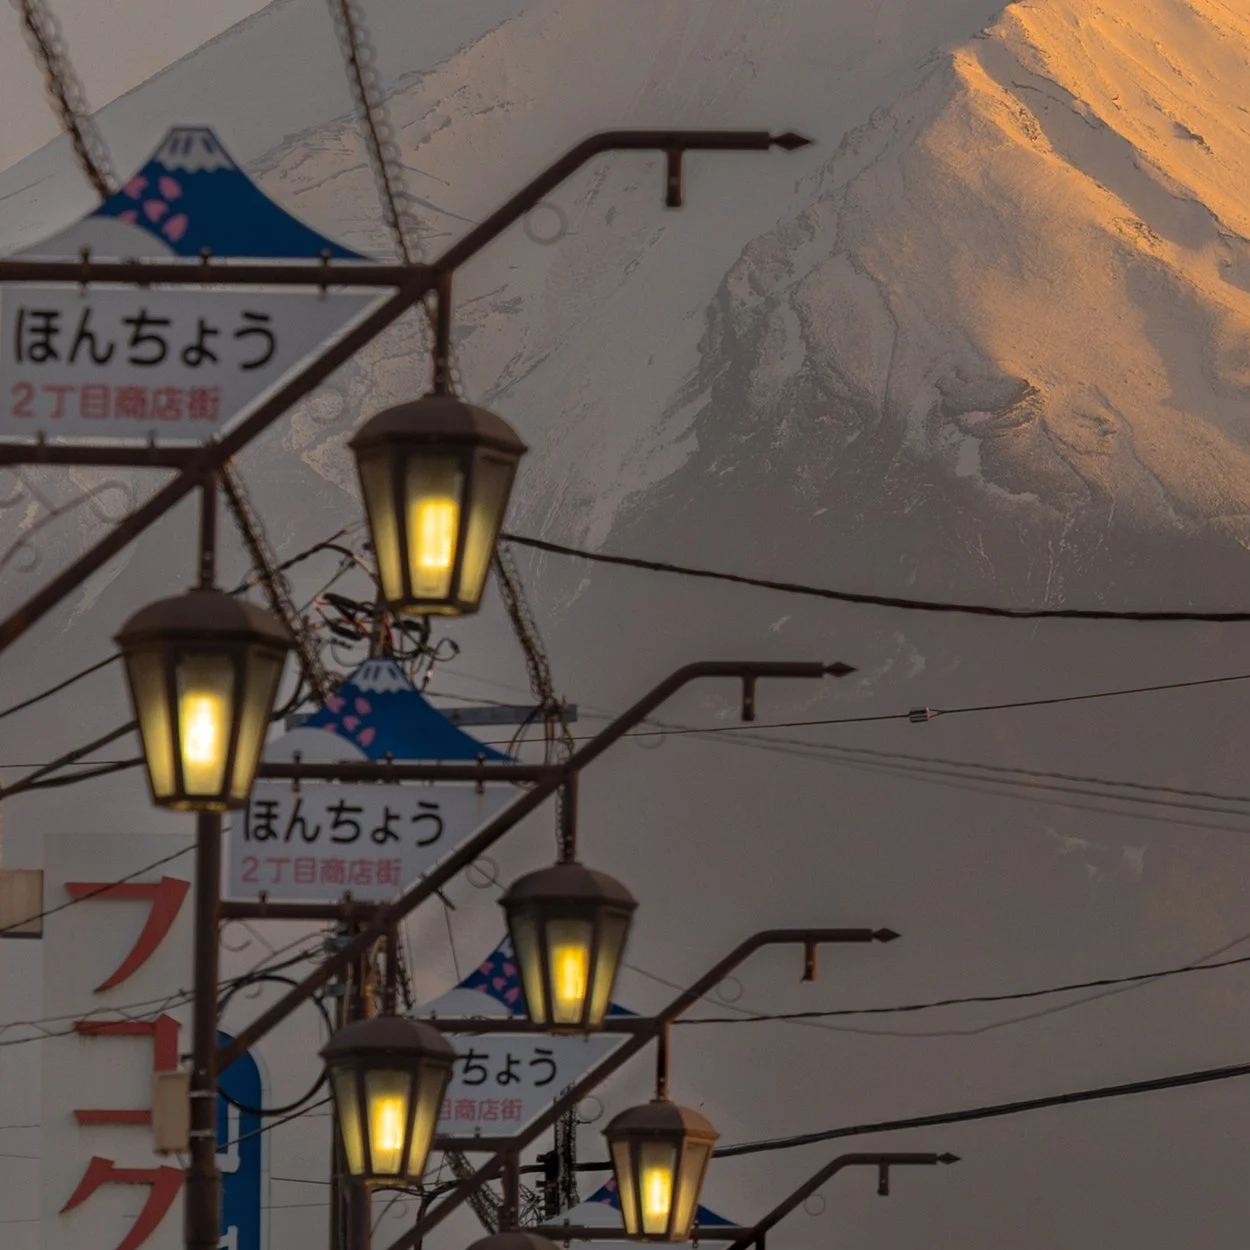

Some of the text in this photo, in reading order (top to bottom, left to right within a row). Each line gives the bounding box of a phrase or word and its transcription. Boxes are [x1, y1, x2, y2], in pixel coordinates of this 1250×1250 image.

[13, 307, 278, 371] ほんちょう
[10, 382, 220, 423] 2丁目商店街
[243, 800, 446, 847] ほんちょう
[241, 857, 403, 885] 2丁目商店街
